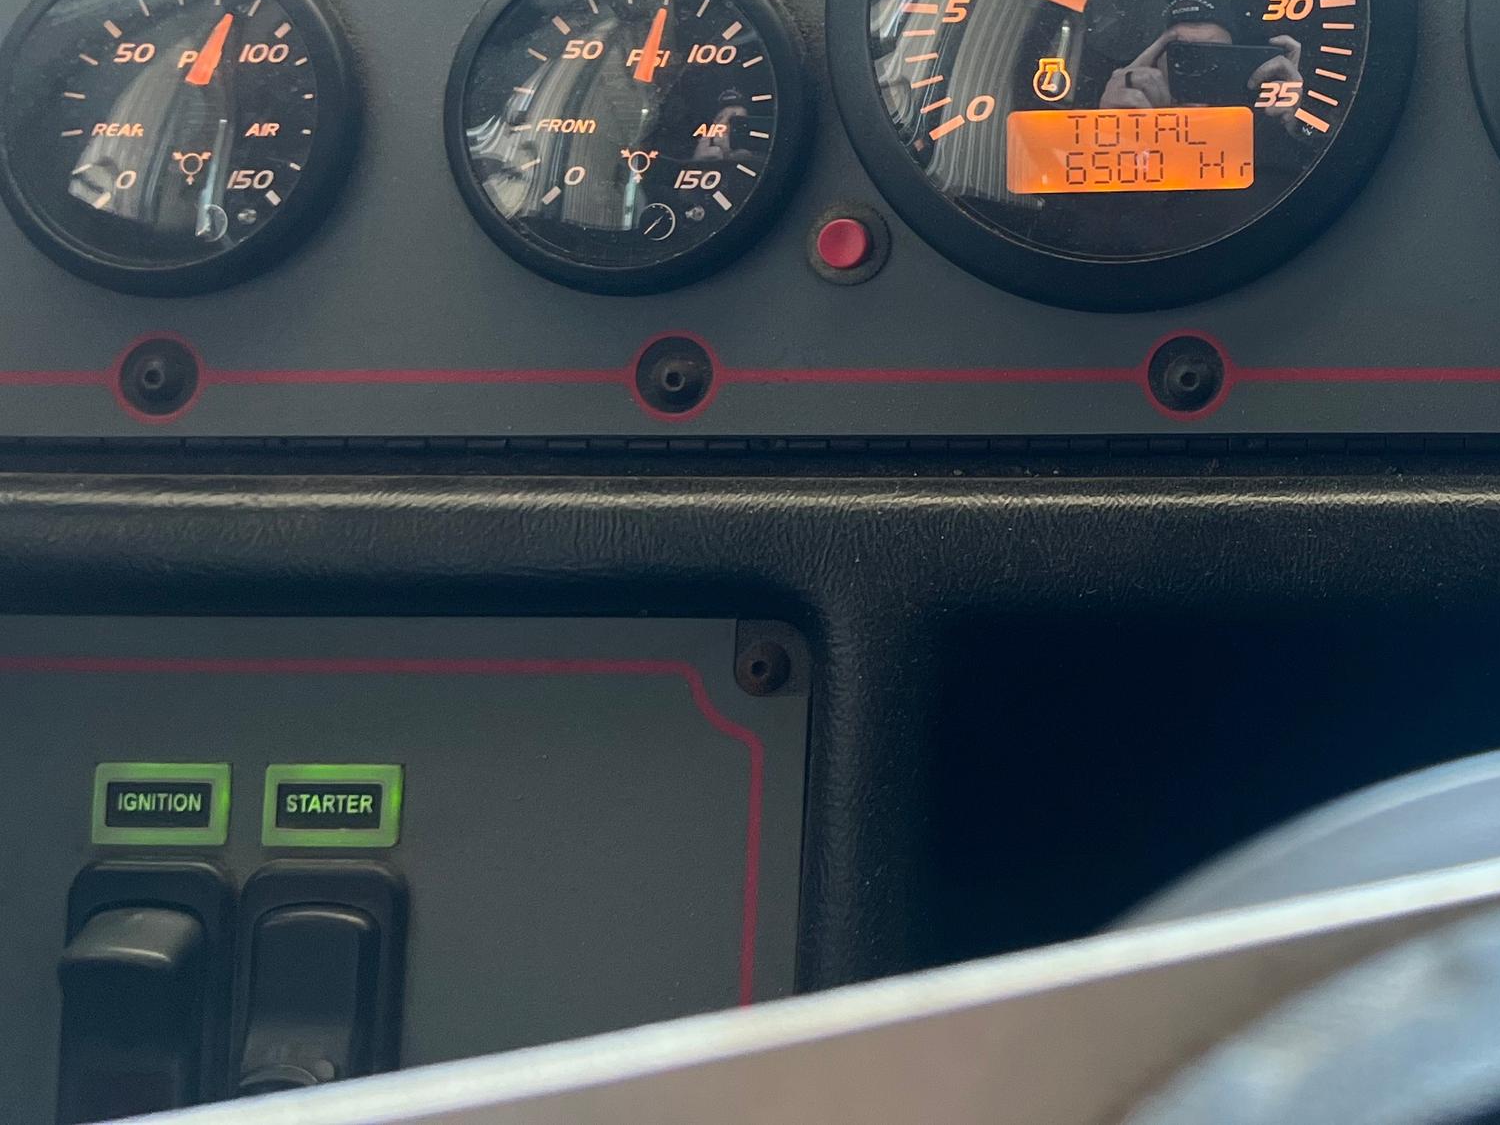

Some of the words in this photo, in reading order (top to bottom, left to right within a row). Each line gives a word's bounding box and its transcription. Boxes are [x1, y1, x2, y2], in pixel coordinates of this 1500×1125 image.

[113, 43, 156, 63] 50
[239, 43, 289, 63] 100
[562, 40, 604, 60] 50
[687, 44, 737, 64] 100
[1254, 82, 1303, 108] 35
[965, 95, 995, 122] 0
[91, 124, 144, 137] REAR
[245, 123, 280, 137] AIR
[536, 119, 596, 133] FRONT
[692, 123, 727, 137] AIR
[1067, 113, 1207, 147] TOTAL
[563, 166, 585, 185] 0
[1066, 151, 1164, 184] 6500
[115, 170, 137, 189] 0
[226, 170, 274, 189] 150
[674, 170, 721, 190] 150
[117, 792, 202, 813] IGNITION
[286, 793, 374, 815] STARTER
